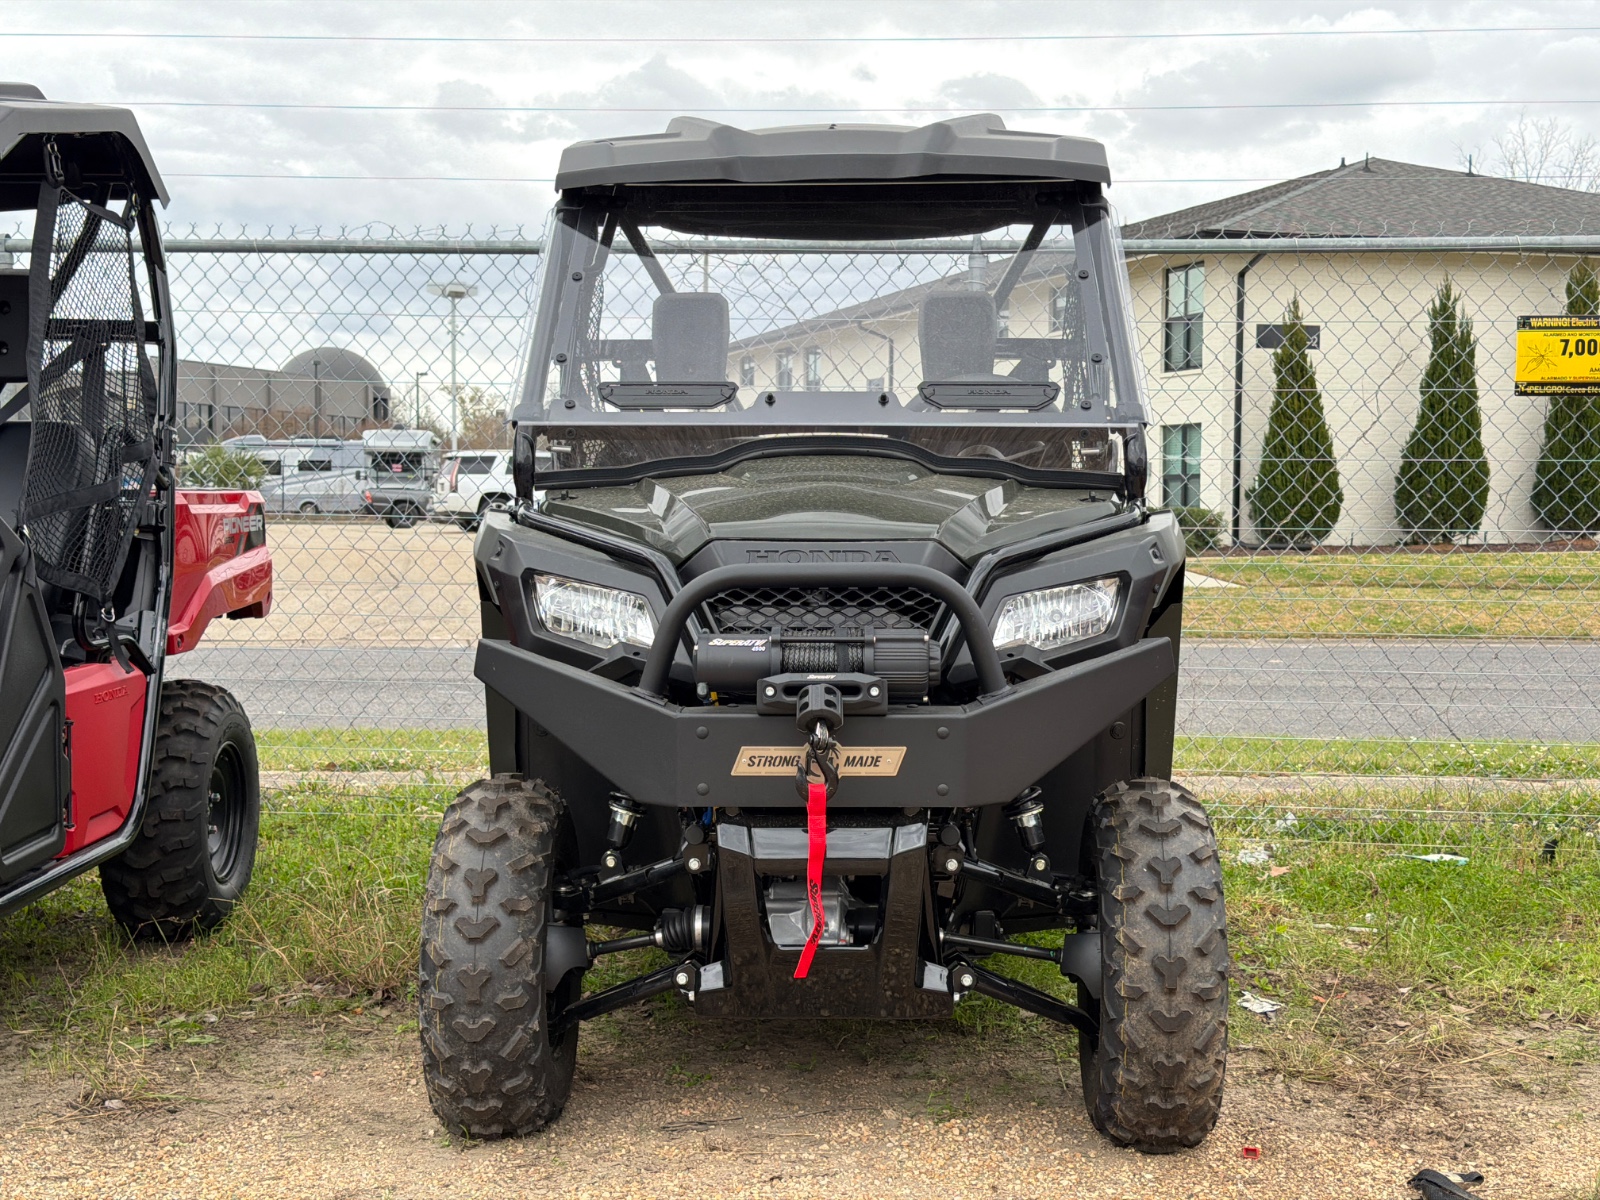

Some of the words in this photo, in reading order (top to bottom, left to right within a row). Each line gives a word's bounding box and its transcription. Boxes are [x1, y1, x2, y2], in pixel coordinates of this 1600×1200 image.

[1530, 317, 1570, 327] WARNING!
[1571, 317, 1598, 327] Electric
[1560, 338, 1600, 358] 7,00
[223, 515, 263, 535] PIONEER
[746, 549, 902, 564] HONDA
[93, 685, 129, 705] HONDA
[747, 755, 802, 768] STRONG
[843, 755, 883, 768] MADE
